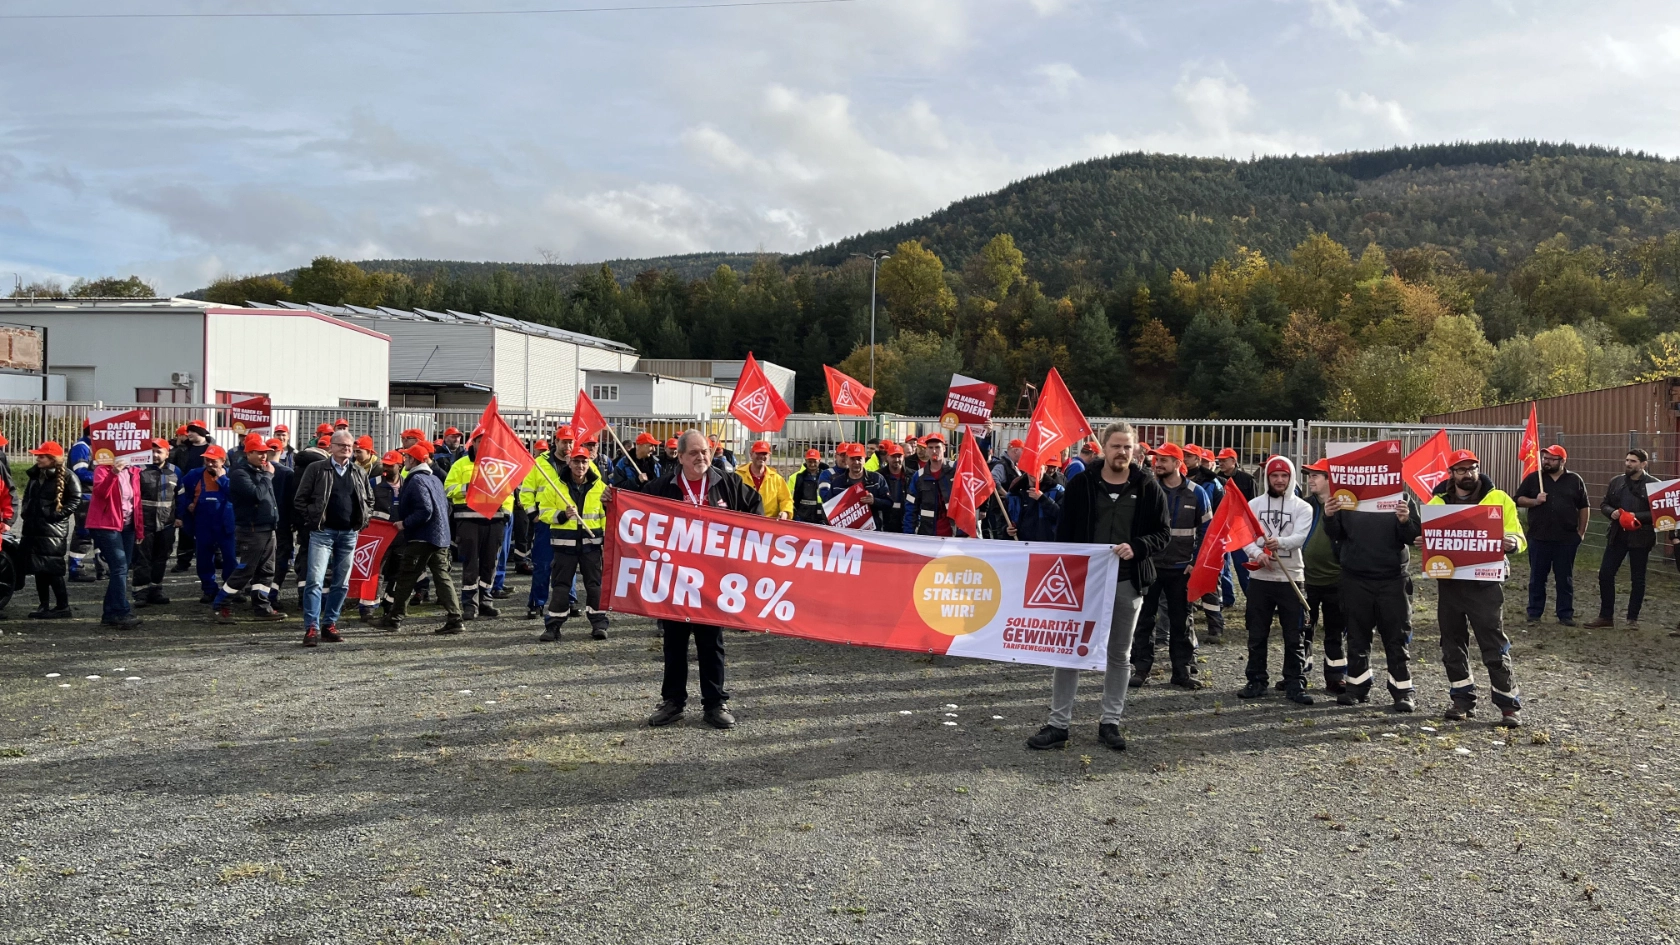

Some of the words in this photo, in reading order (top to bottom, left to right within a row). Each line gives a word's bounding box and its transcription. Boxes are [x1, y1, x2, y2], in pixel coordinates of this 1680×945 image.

[949, 391, 960, 401] WIR
[947, 398, 992, 419] VERDIENT!
[233, 412, 270, 423] VERDIENT!
[107, 420, 137, 430] DAFÜR
[92, 429, 150, 441] STREITEN
[115, 439, 142, 451] WIR
[1329, 464, 1346, 473] WIR
[1347, 465, 1376, 473] HABEN
[1377, 464, 1389, 473] ES
[1331, 472, 1400, 486] VERDIENT!
[1424, 529, 1442, 537] WIR
[1444, 529, 1474, 538] HABEN
[1477, 530, 1488, 538] ES
[618, 509, 863, 576] GEMEINSAM
[1425, 538, 1502, 552] VERDIENT!
[614, 550, 705, 609] FÜR
[934, 569, 983, 585] DAFÜR
[923, 588, 993, 601] STREITEN
[941, 604, 975, 618] WIR!
[1006, 617, 1081, 633] SOLIDARITÄT
[1003, 642, 1056, 653] TARIFBEWEGUNG
[1056, 647, 1074, 655] 2022
